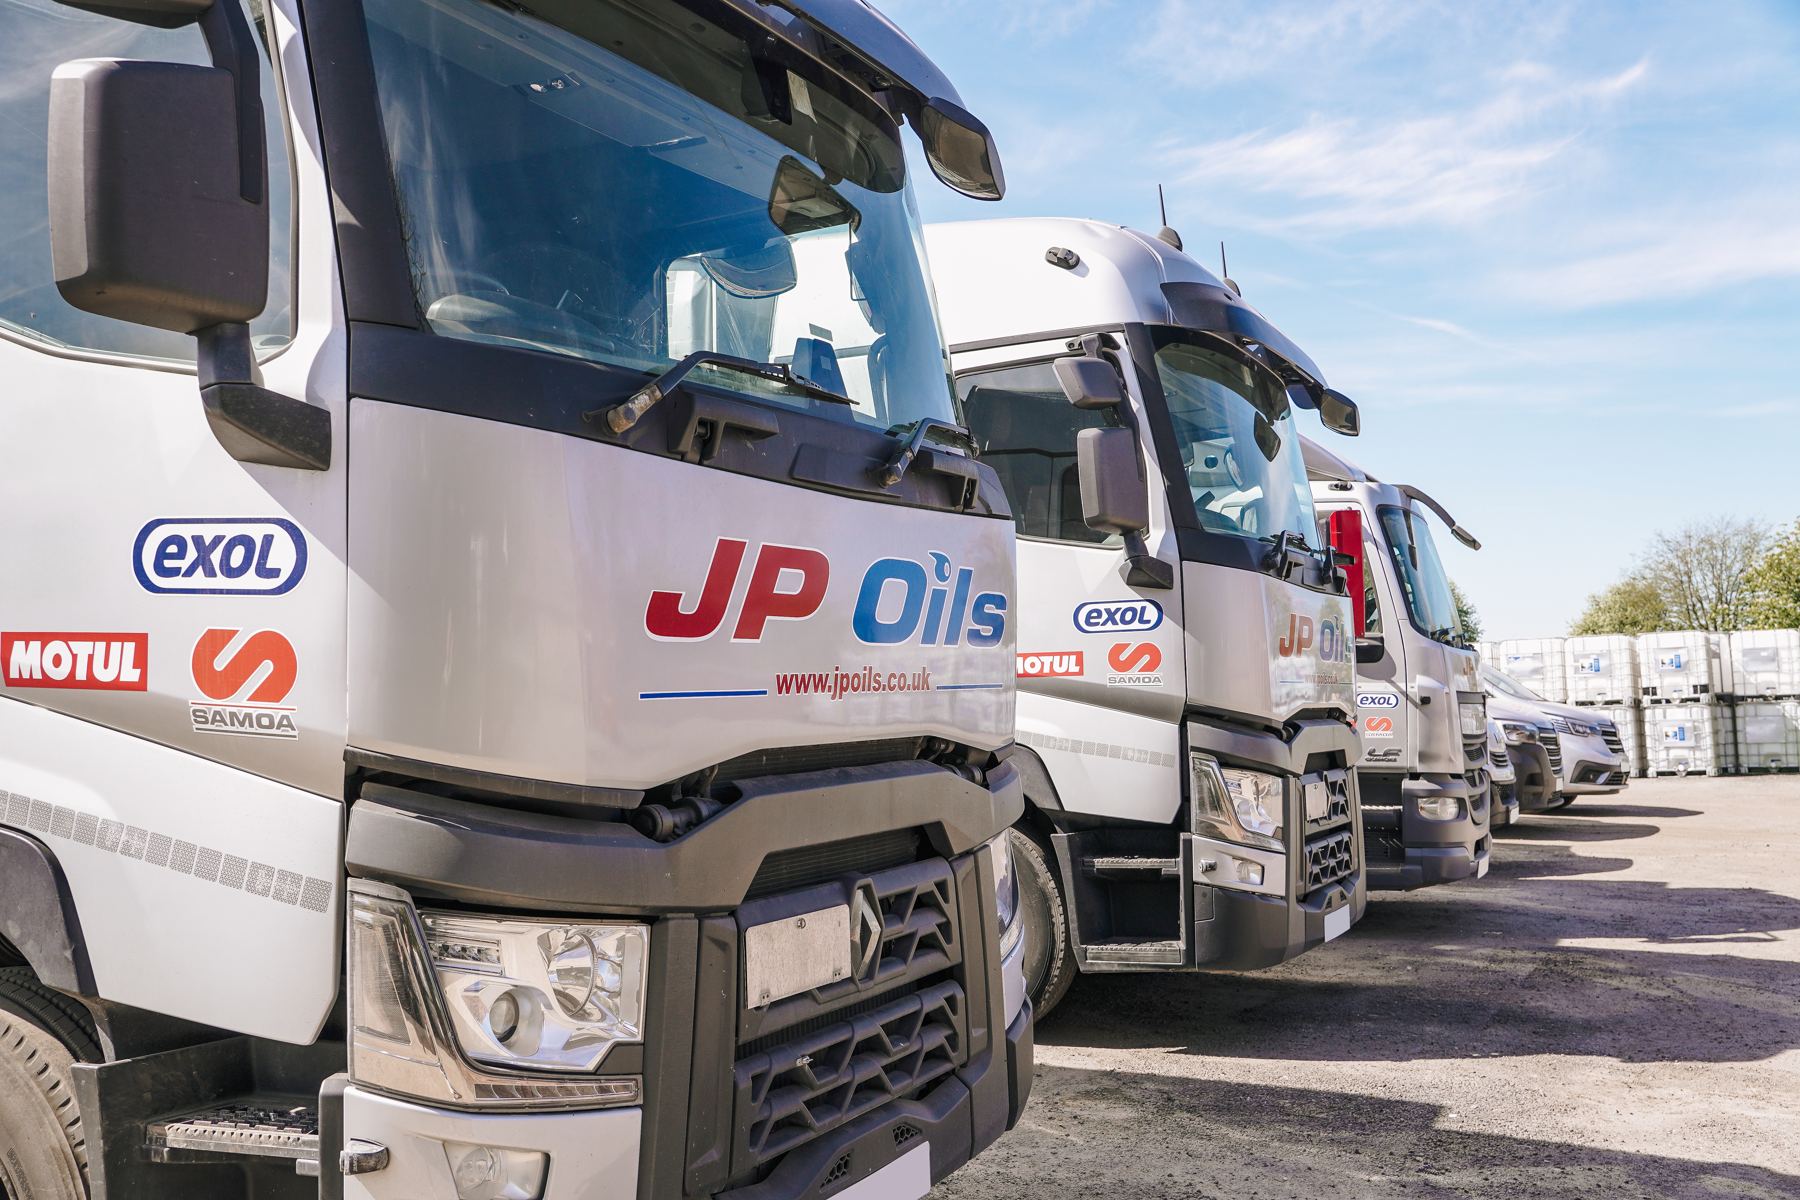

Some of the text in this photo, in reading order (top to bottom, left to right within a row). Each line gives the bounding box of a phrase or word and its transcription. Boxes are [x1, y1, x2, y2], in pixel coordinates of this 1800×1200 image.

[645, 536, 1008, 648] JP Oils
[1279, 613, 1313, 657] JP
[10, 640, 141, 682] MOTUL
[1108, 676, 1162, 684] SAMOA
[776, 666, 931, 700] www.jpoils.co.uk
[191, 708, 296, 731] SAMOA
